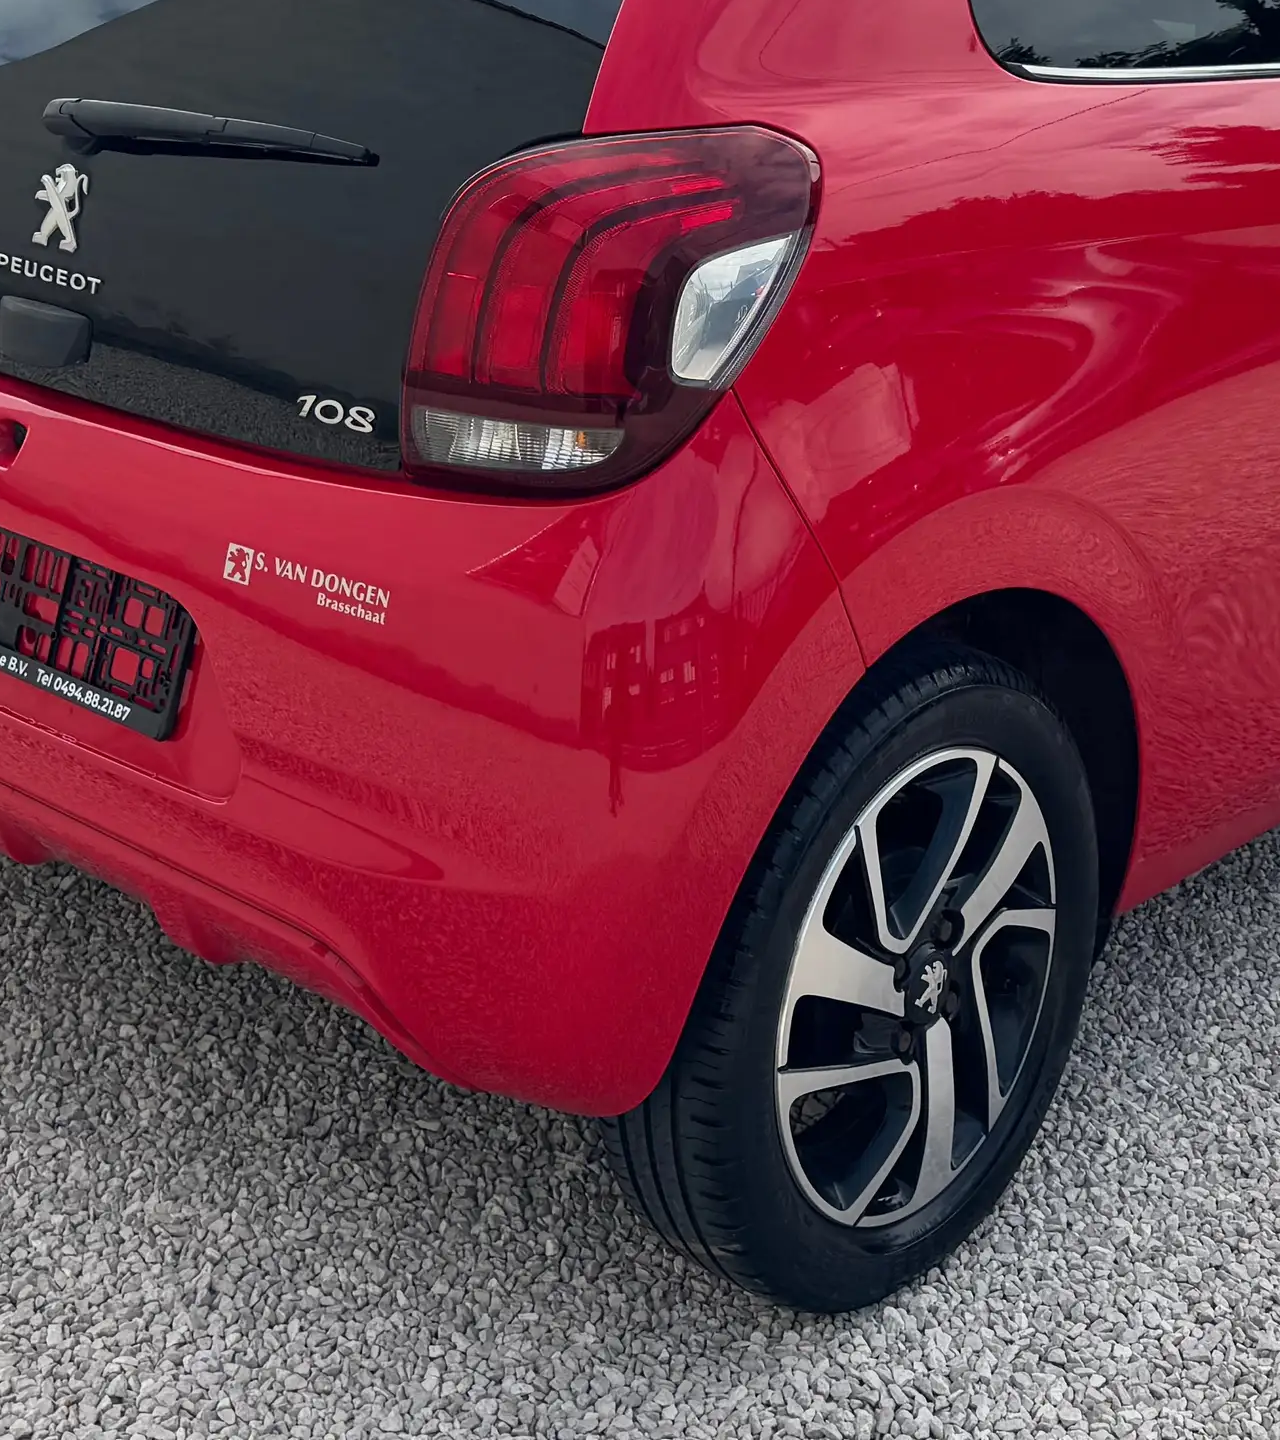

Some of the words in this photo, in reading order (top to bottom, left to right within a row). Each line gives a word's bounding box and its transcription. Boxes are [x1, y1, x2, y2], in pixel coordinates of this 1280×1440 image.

[296, 395, 376, 434] 108
[254, 551, 268, 573] S.
[274, 557, 308, 584] VAN
[311, 569, 390, 608] DONGEN
[316, 592, 386, 625] Brasschaat
[7, 656, 29, 677] B.V.
[36, 668, 52, 687] Tel
[53, 677, 131, 722] 0494.88.21.87
